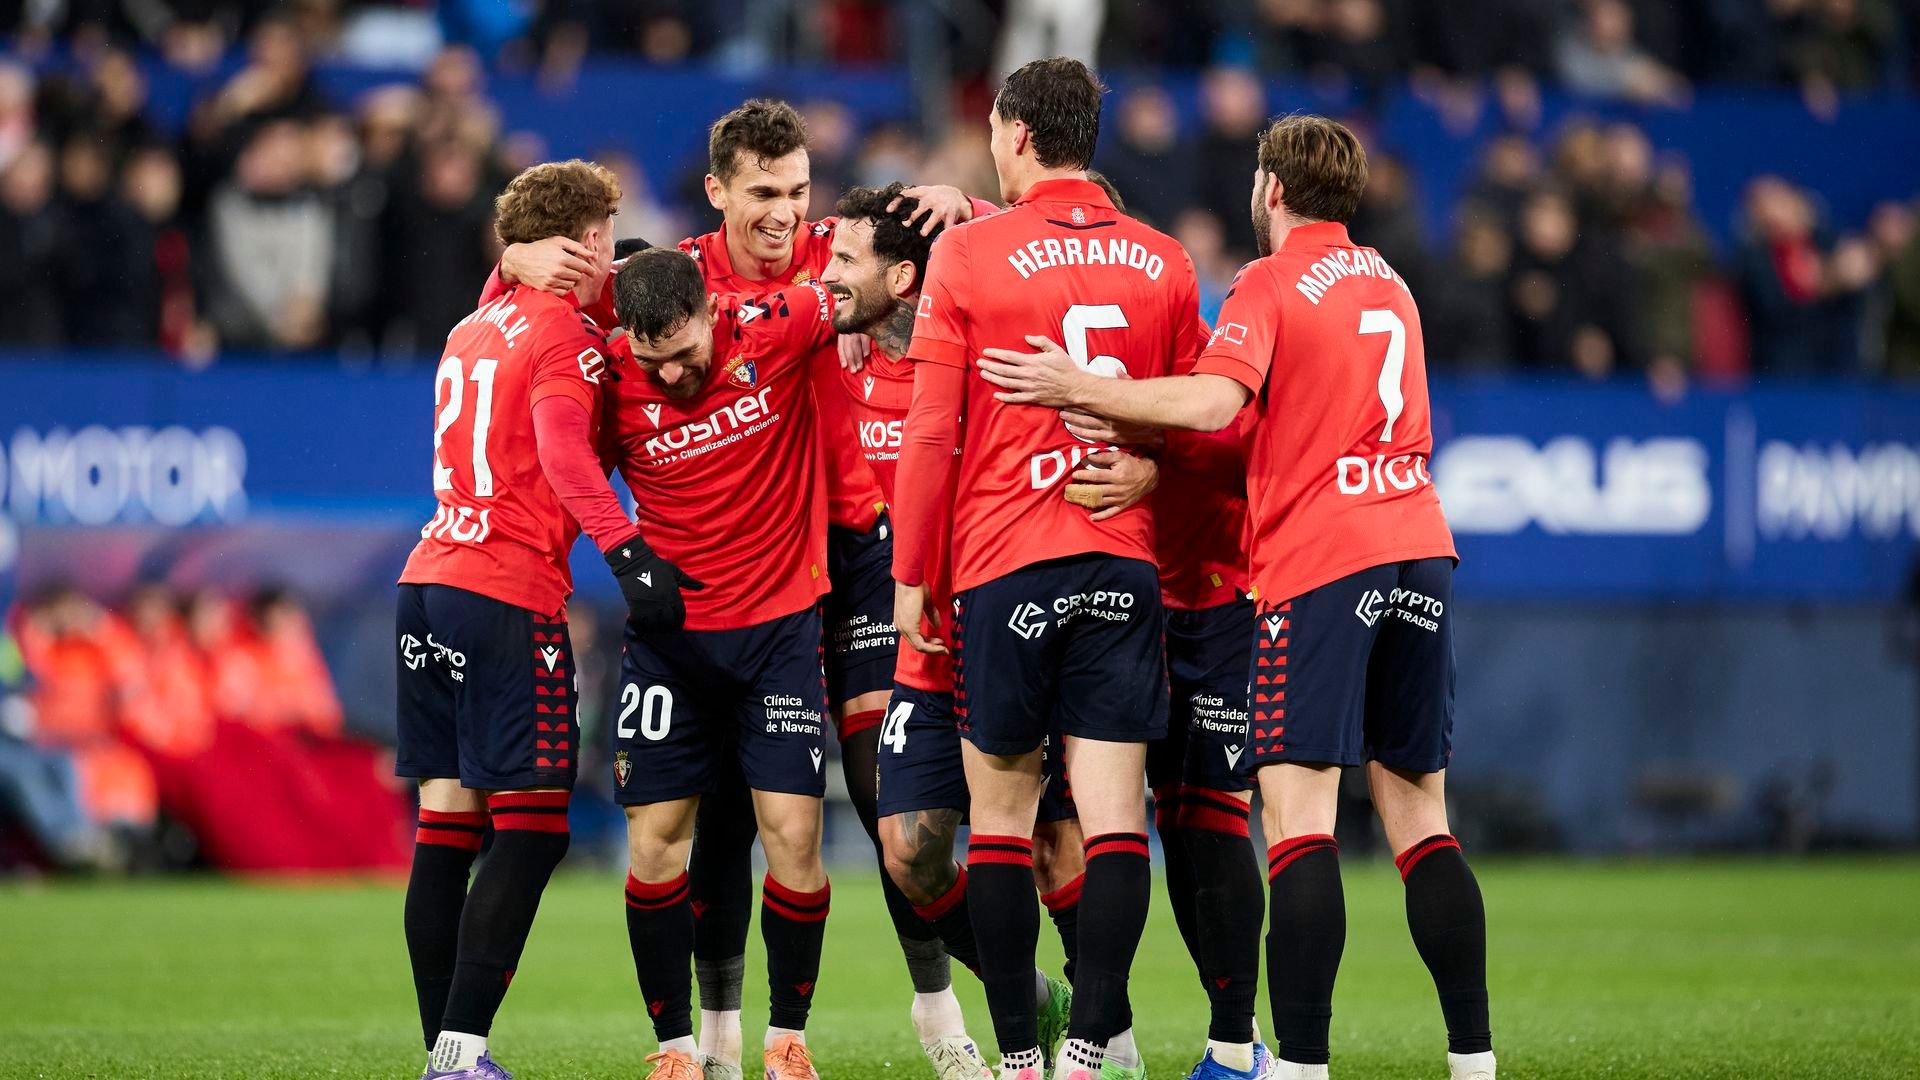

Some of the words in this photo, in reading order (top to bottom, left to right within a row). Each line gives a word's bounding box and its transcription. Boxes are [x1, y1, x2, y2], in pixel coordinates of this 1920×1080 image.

[1007, 238, 1165, 281] HERRANDO
[1357, 309, 1406, 443] 7
[433, 355, 499, 497] 21
[679, 433, 743, 460] Climatización
[743, 413, 781, 438] eficiente
[859, 419, 906, 449] KOS
[1052, 590, 1135, 615] CRYPTO
[1084, 607, 1131, 622] TRADER
[1396, 608, 1439, 633] TRADER
[850, 635, 896, 651] Navarra
[616, 682, 674, 742] 20
[763, 694, 803, 707] Clínica
[765, 720, 779, 733] de
[781, 720, 821, 736] Navarra
[766, 707, 822, 724] Universidad
[1201, 718, 1246, 735] Navarra
